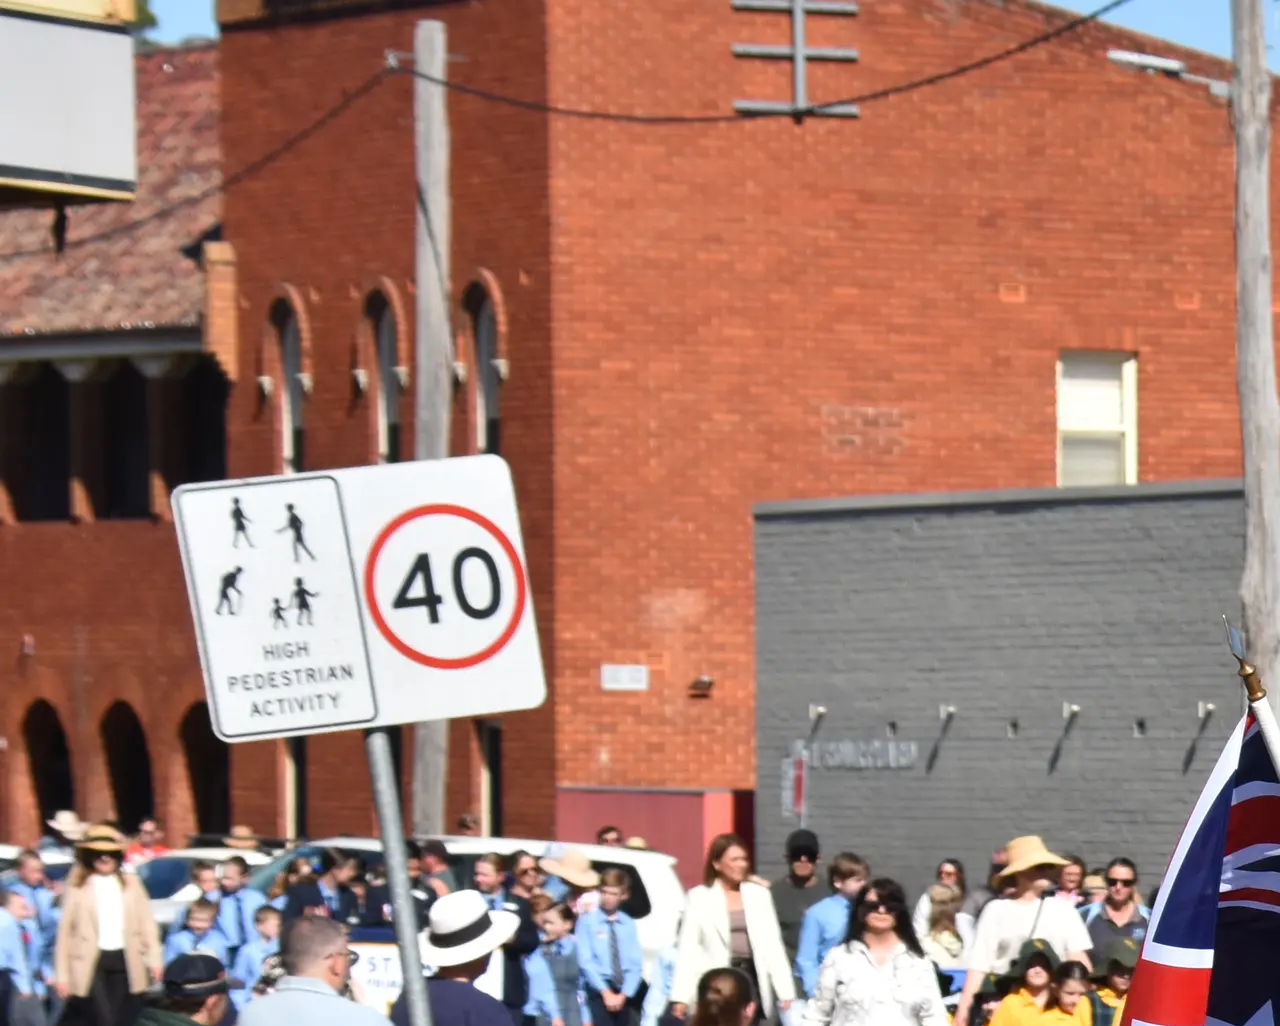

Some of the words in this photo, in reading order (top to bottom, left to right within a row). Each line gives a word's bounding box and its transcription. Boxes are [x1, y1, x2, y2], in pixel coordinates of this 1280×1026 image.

[391, 546, 501, 625] 40
[262, 641, 311, 661] HIGH
[227, 664, 354, 693] PEDESTRIAN
[250, 692, 342, 718] ACTIVITY
